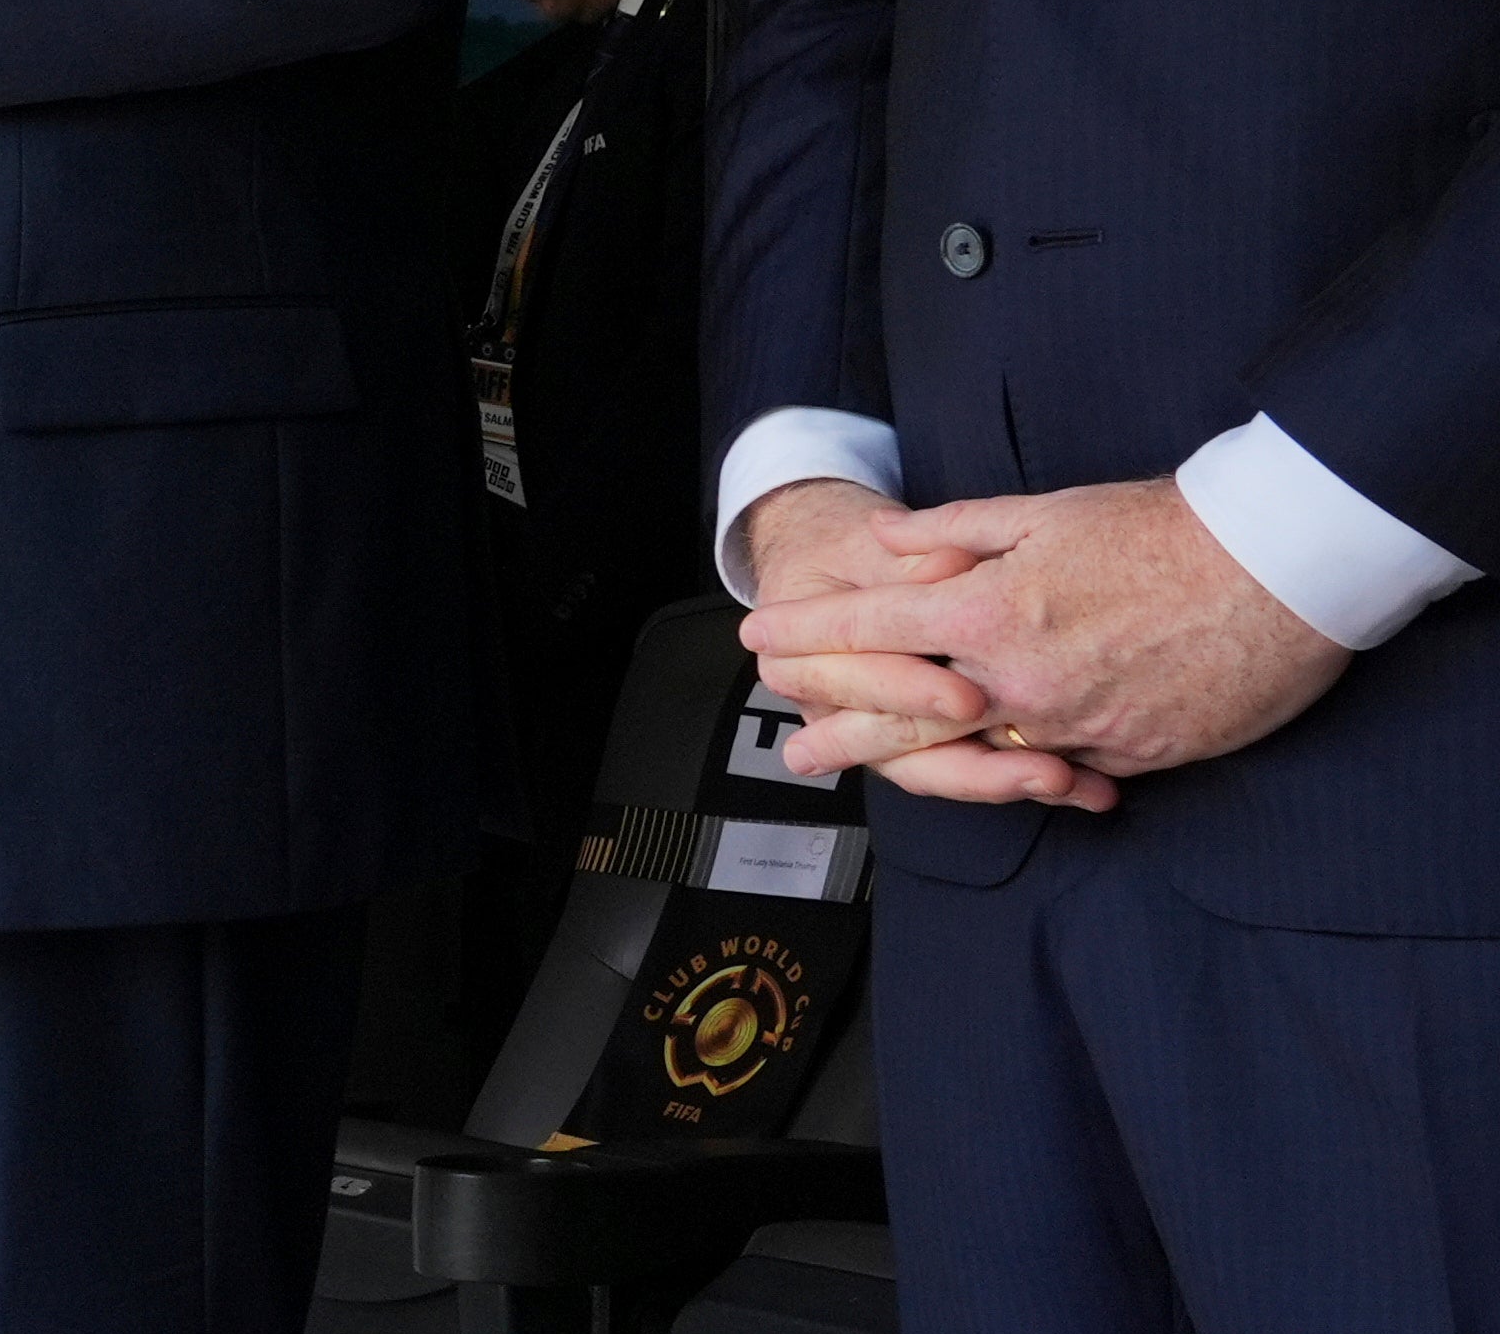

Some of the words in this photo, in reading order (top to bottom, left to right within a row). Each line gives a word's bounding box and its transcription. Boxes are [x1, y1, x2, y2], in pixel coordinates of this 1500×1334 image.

[584, 132, 607, 156] IFA
[515, 201, 534, 230] CLUB
[529, 162, 555, 200] WORLD
[643, 953, 708, 1022] CLUB
[720, 935, 803, 983] WORLD
[782, 994, 811, 1052] CUP
[662, 1100, 702, 1123] FIFA
